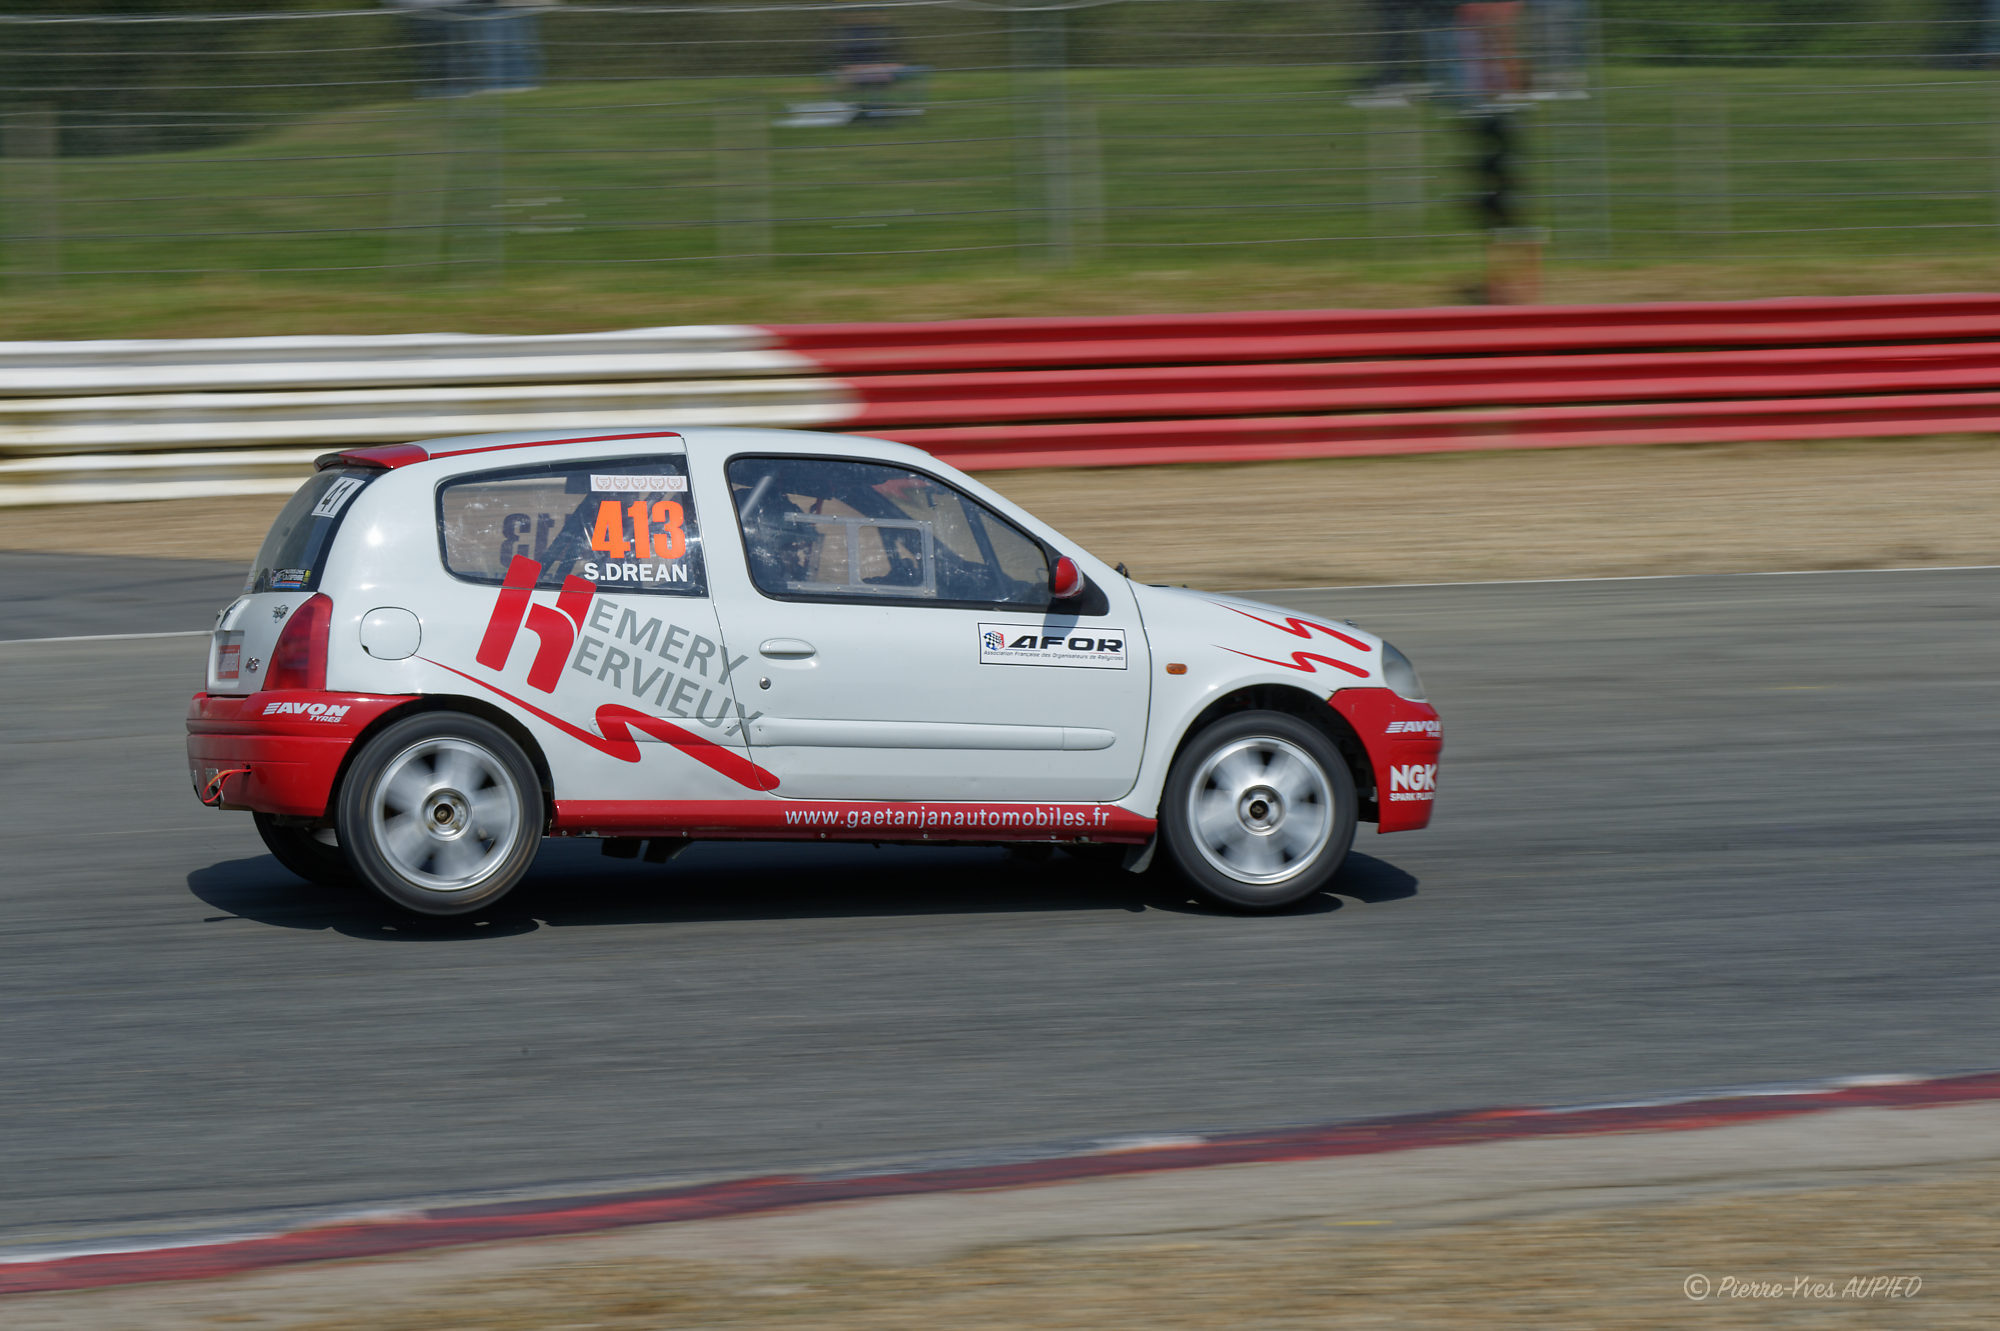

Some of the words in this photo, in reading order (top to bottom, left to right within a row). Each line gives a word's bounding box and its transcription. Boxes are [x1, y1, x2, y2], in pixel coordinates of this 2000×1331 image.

[591, 500, 687, 560] 413
[583, 563, 688, 583] S.DREAN
[588, 598, 750, 686] EMERY
[1008, 635, 1123, 653] AFOR
[571, 635, 764, 746] ERVIEUX
[276, 702, 351, 717] AVON
[309, 715, 342, 723] TYRES
[1389, 764, 1438, 791] NGK
[1389, 793, 1416, 801] SPARK
[785, 807, 1110, 829] www.gaetanjanautomobiles.fr
